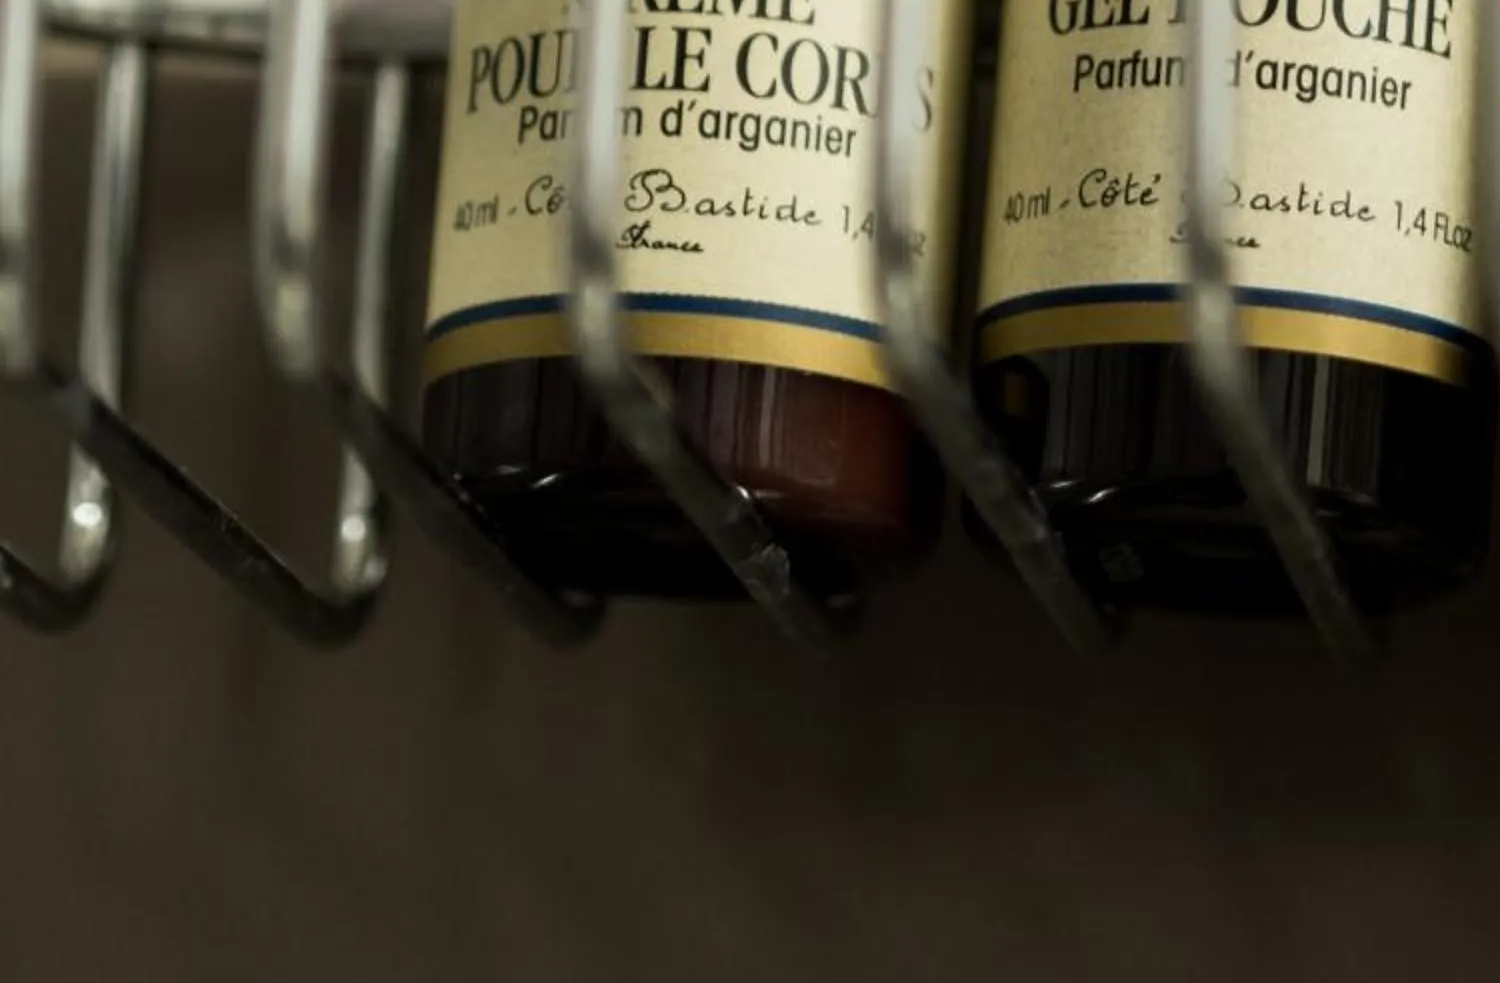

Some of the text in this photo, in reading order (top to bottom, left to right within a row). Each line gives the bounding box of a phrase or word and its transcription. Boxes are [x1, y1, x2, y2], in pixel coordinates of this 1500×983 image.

[629, 26, 712, 93] LE
[736, 32, 934, 133] CORS
[1078, 167, 1161, 209] Côté
[1394, 200, 1427, 238] 1,4
